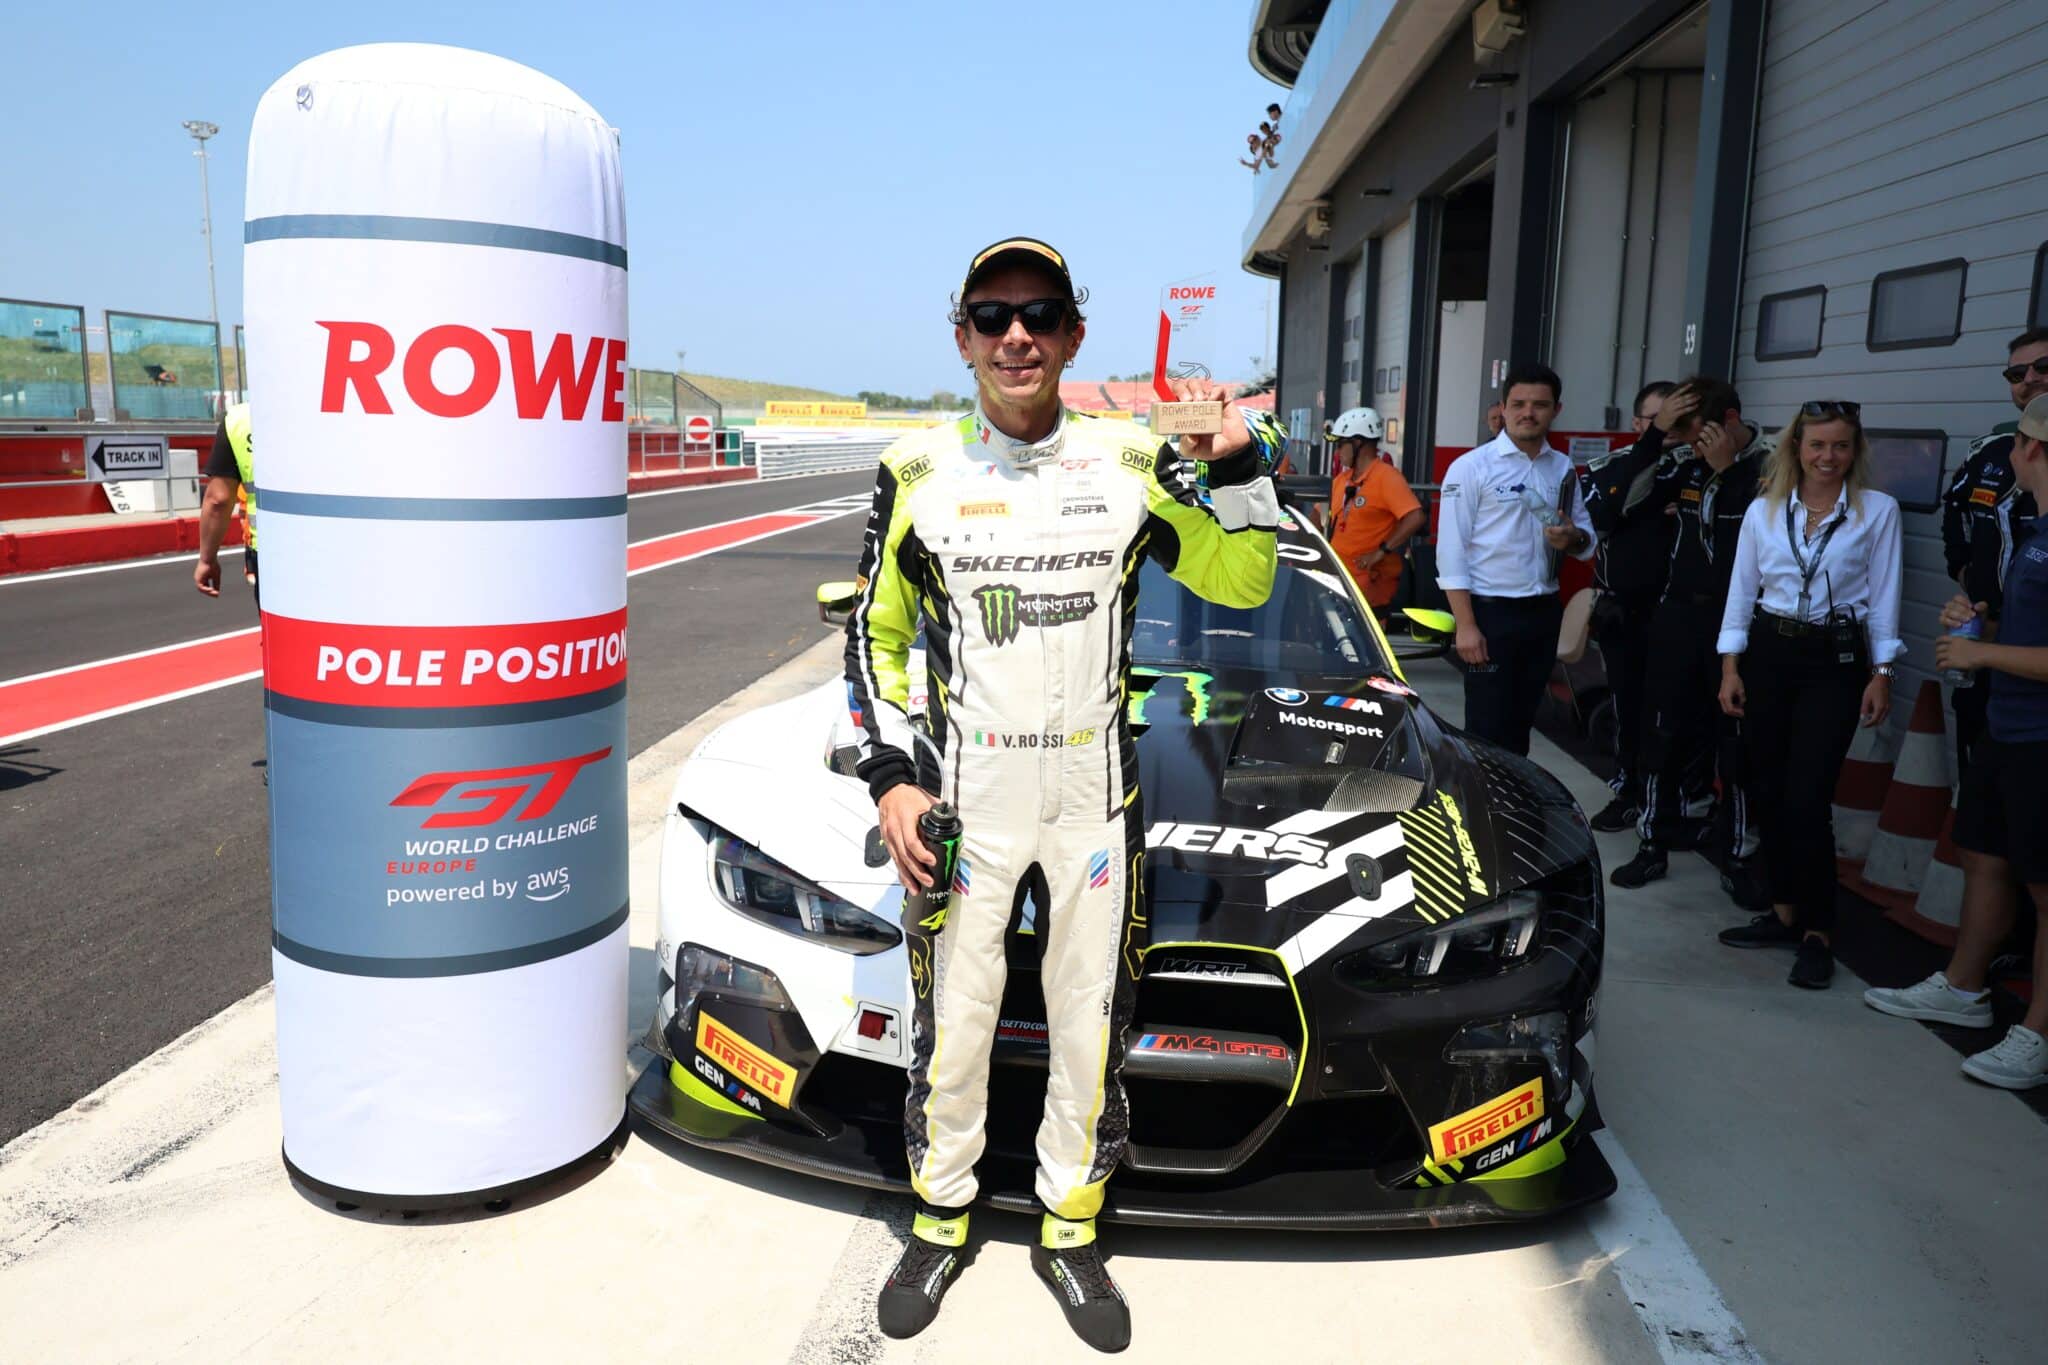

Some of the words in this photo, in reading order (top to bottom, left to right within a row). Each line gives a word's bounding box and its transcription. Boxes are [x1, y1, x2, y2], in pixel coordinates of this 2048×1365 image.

[1170, 287, 1216, 299] ROWE
[315, 320, 627, 422] ROWE
[1162, 405, 1188, 416] ROWE
[1193, 405, 1217, 416] POLE
[1174, 419, 1207, 430] AWARD
[107, 451, 146, 463] TRACK
[149, 451, 159, 462] IN
[1121, 449, 1154, 470] OMP
[901, 458, 932, 483] OMP
[960, 503, 1006, 516] PIRELLI
[951, 550, 1114, 573] SKECHERS
[1018, 596, 1092, 613] MONSTER
[316, 645, 446, 686] POLE
[460, 627, 627, 685] POSITION
[1278, 711, 1384, 738] Motorsport
[1065, 728, 1097, 747] 46
[405, 837, 489, 856] WORLD
[495, 815, 598, 850] CHALLENGE
[386, 859, 477, 875] EUROPE
[387, 880, 485, 906] powered
[493, 880, 518, 899] by
[526, 867, 569, 891] aws
[1160, 958, 1247, 978] WRT
[704, 1024, 786, 1096] PIRELLI
[1224, 1041, 1286, 1060] GT3
[694, 1055, 725, 1088] GEN
[1441, 1090, 1535, 1157] PIRELLI
[1476, 1140, 1515, 1170] GEN
[936, 1227, 956, 1237] OMP
[1058, 1230, 1077, 1239] OMP
